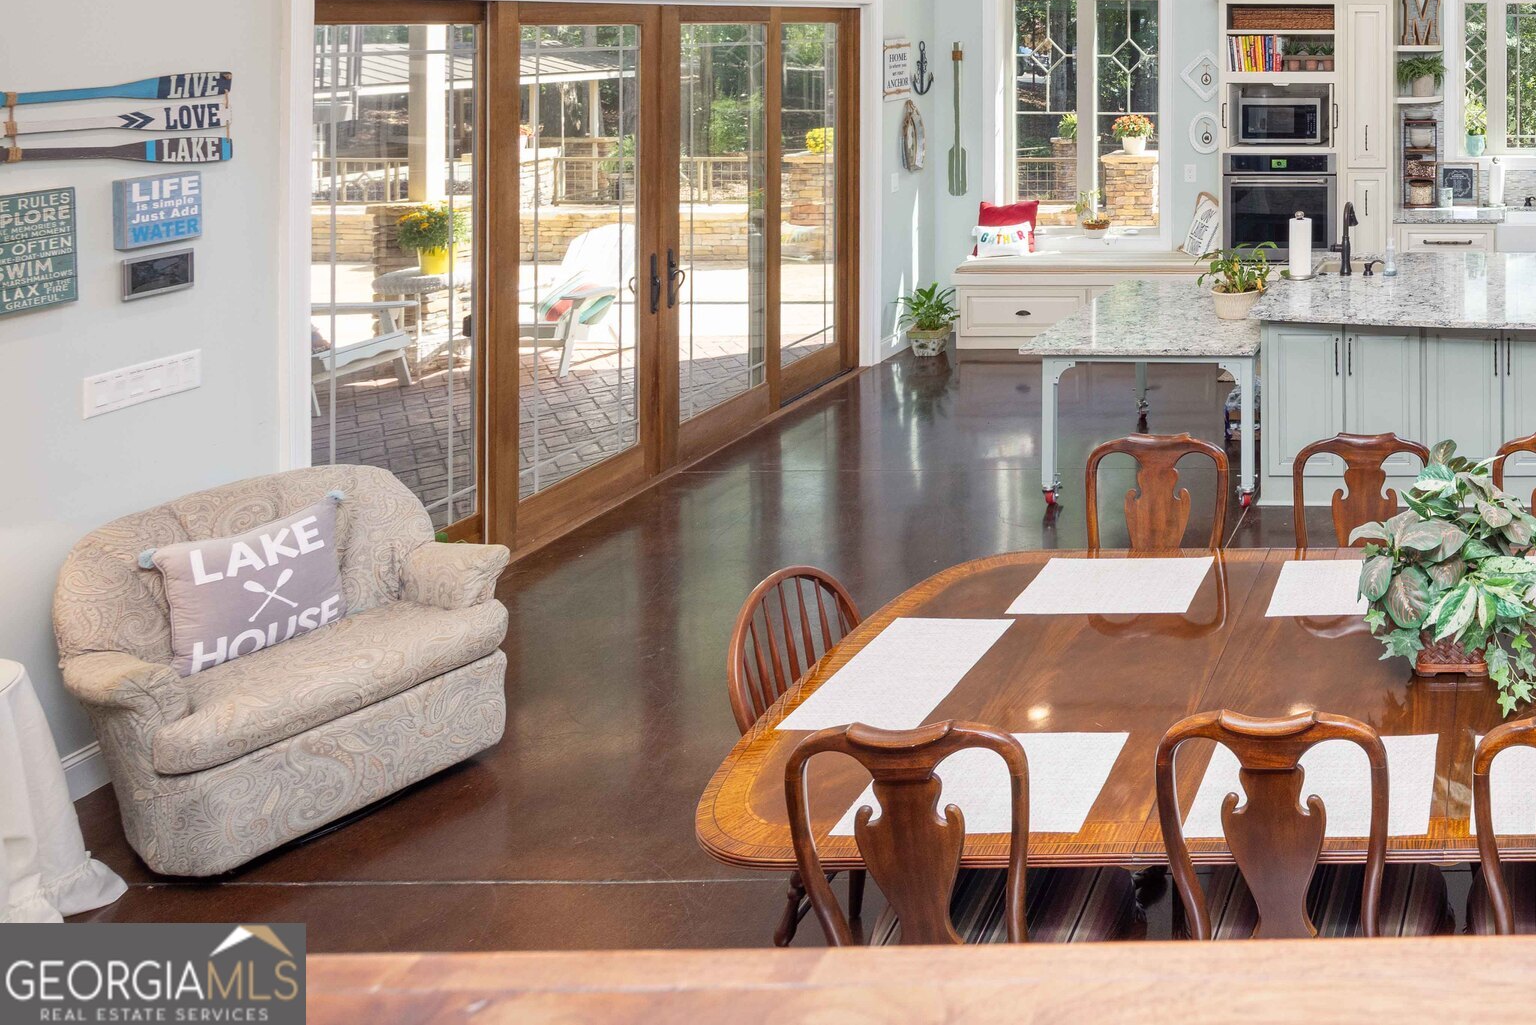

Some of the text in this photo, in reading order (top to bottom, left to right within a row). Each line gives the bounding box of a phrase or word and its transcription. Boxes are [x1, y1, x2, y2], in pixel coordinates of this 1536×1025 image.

[889, 53, 908, 63] HOME
[167, 72, 220, 98] LIVE
[887, 77, 909, 89] ANCHOR
[164, 104, 220, 129] LOVE
[162, 138, 219, 162] LAKE
[132, 176, 199, 202] LIFE
[18, 193, 70, 210] RULES
[136, 196, 194, 211] is simple
[131, 205, 198, 224] Just Add
[4, 232, 28, 242] EACH
[31, 226, 71, 237] MOMENT
[11, 222, 57, 235] MEMORIES
[132, 218, 200, 243] WATER
[11, 236, 72, 255] OFTEN
[2, 270, 73, 288] MARSHMALLOWS
[43, 278, 72, 289] BY THE
[46, 284, 69, 294] FIRE
[5, 293, 60, 310] GRATEFUL
[189, 515, 325, 586] LAKE
[190, 594, 340, 676] HOUSE
